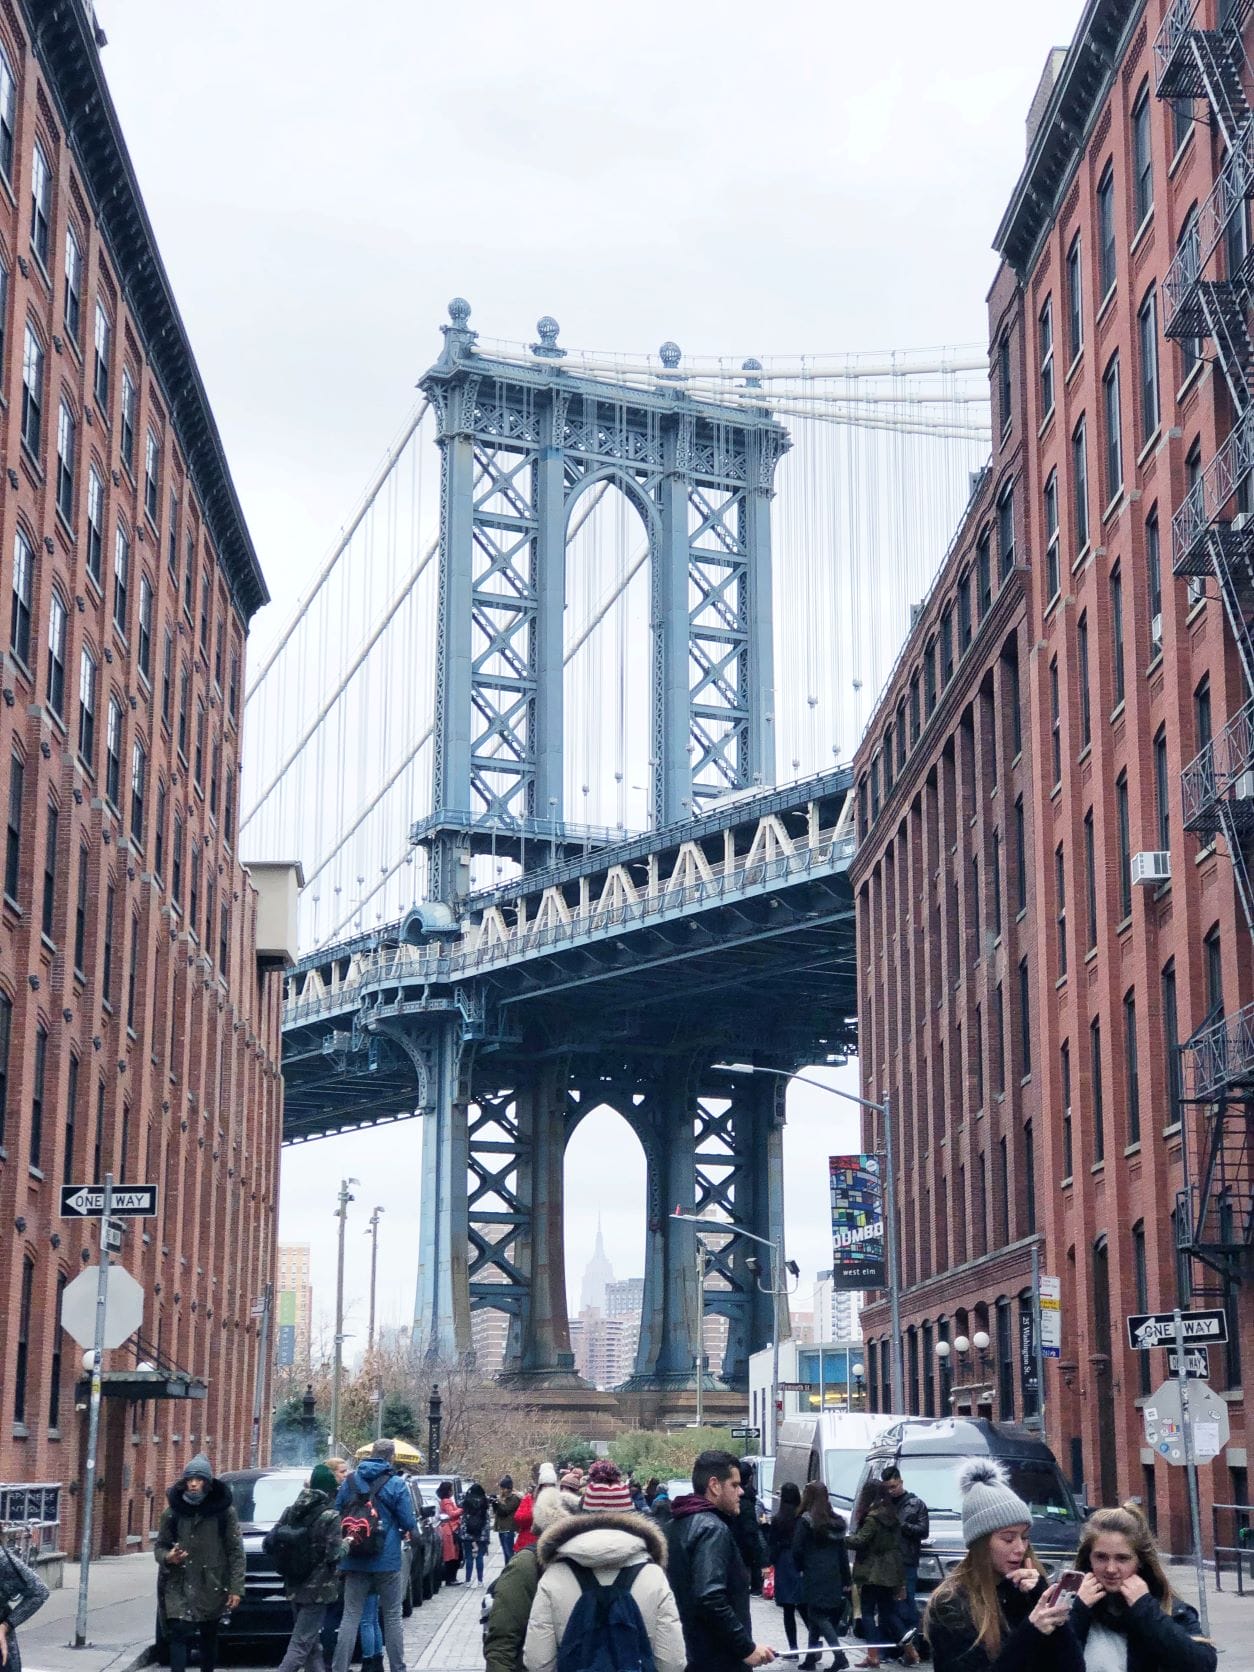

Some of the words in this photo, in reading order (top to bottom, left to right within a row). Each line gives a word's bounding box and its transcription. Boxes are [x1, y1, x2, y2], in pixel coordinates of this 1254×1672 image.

[75, 1195, 102, 1207] ONE
[115, 1194, 144, 1207] WAY
[832, 1221, 884, 1249] DUMBO
[1022, 1316, 1030, 1325] 25
[1144, 1323, 1172, 1338] ONE
[1184, 1320, 1213, 1335] WAY
[1022, 1326, 1031, 1365] Washington
